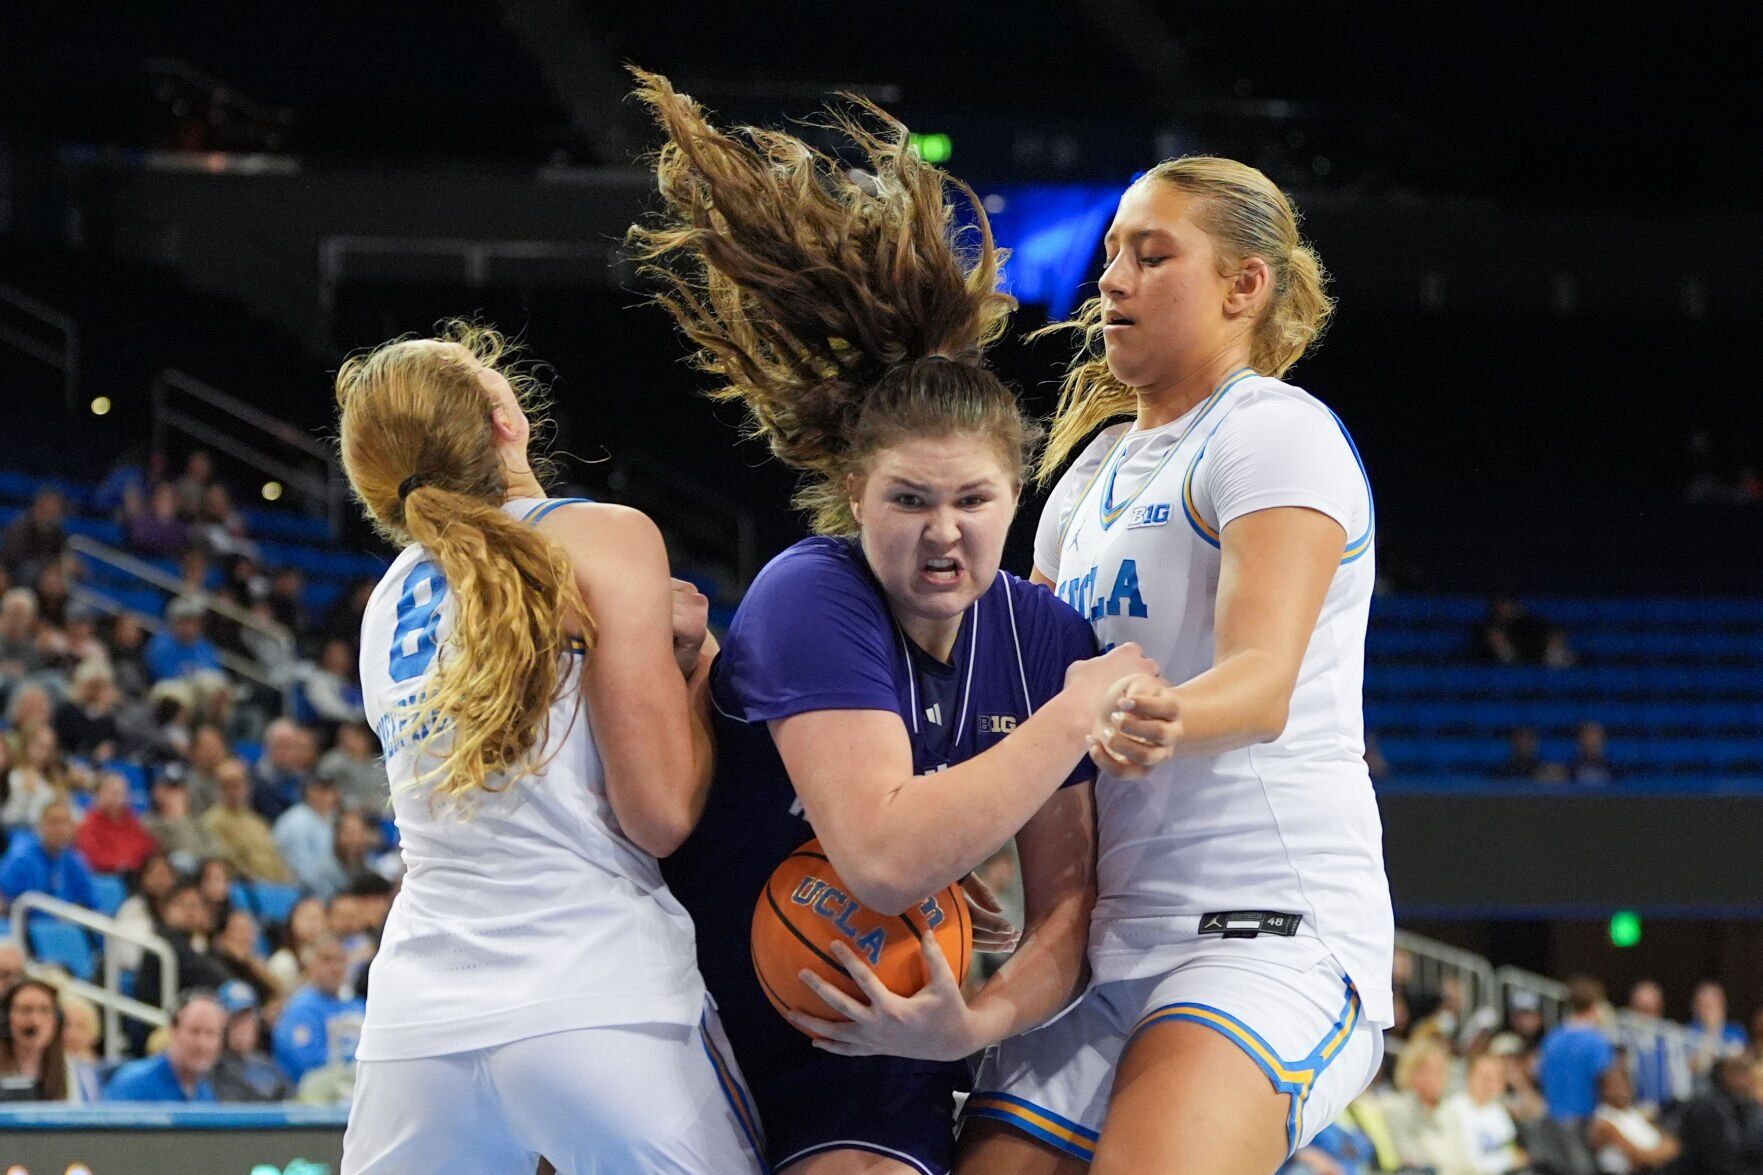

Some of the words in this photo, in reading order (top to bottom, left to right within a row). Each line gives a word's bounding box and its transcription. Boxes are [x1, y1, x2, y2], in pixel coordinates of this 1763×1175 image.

[388, 560, 448, 684] 8
[791, 875, 888, 967] UCLA
[1266, 917, 1285, 927] 48
